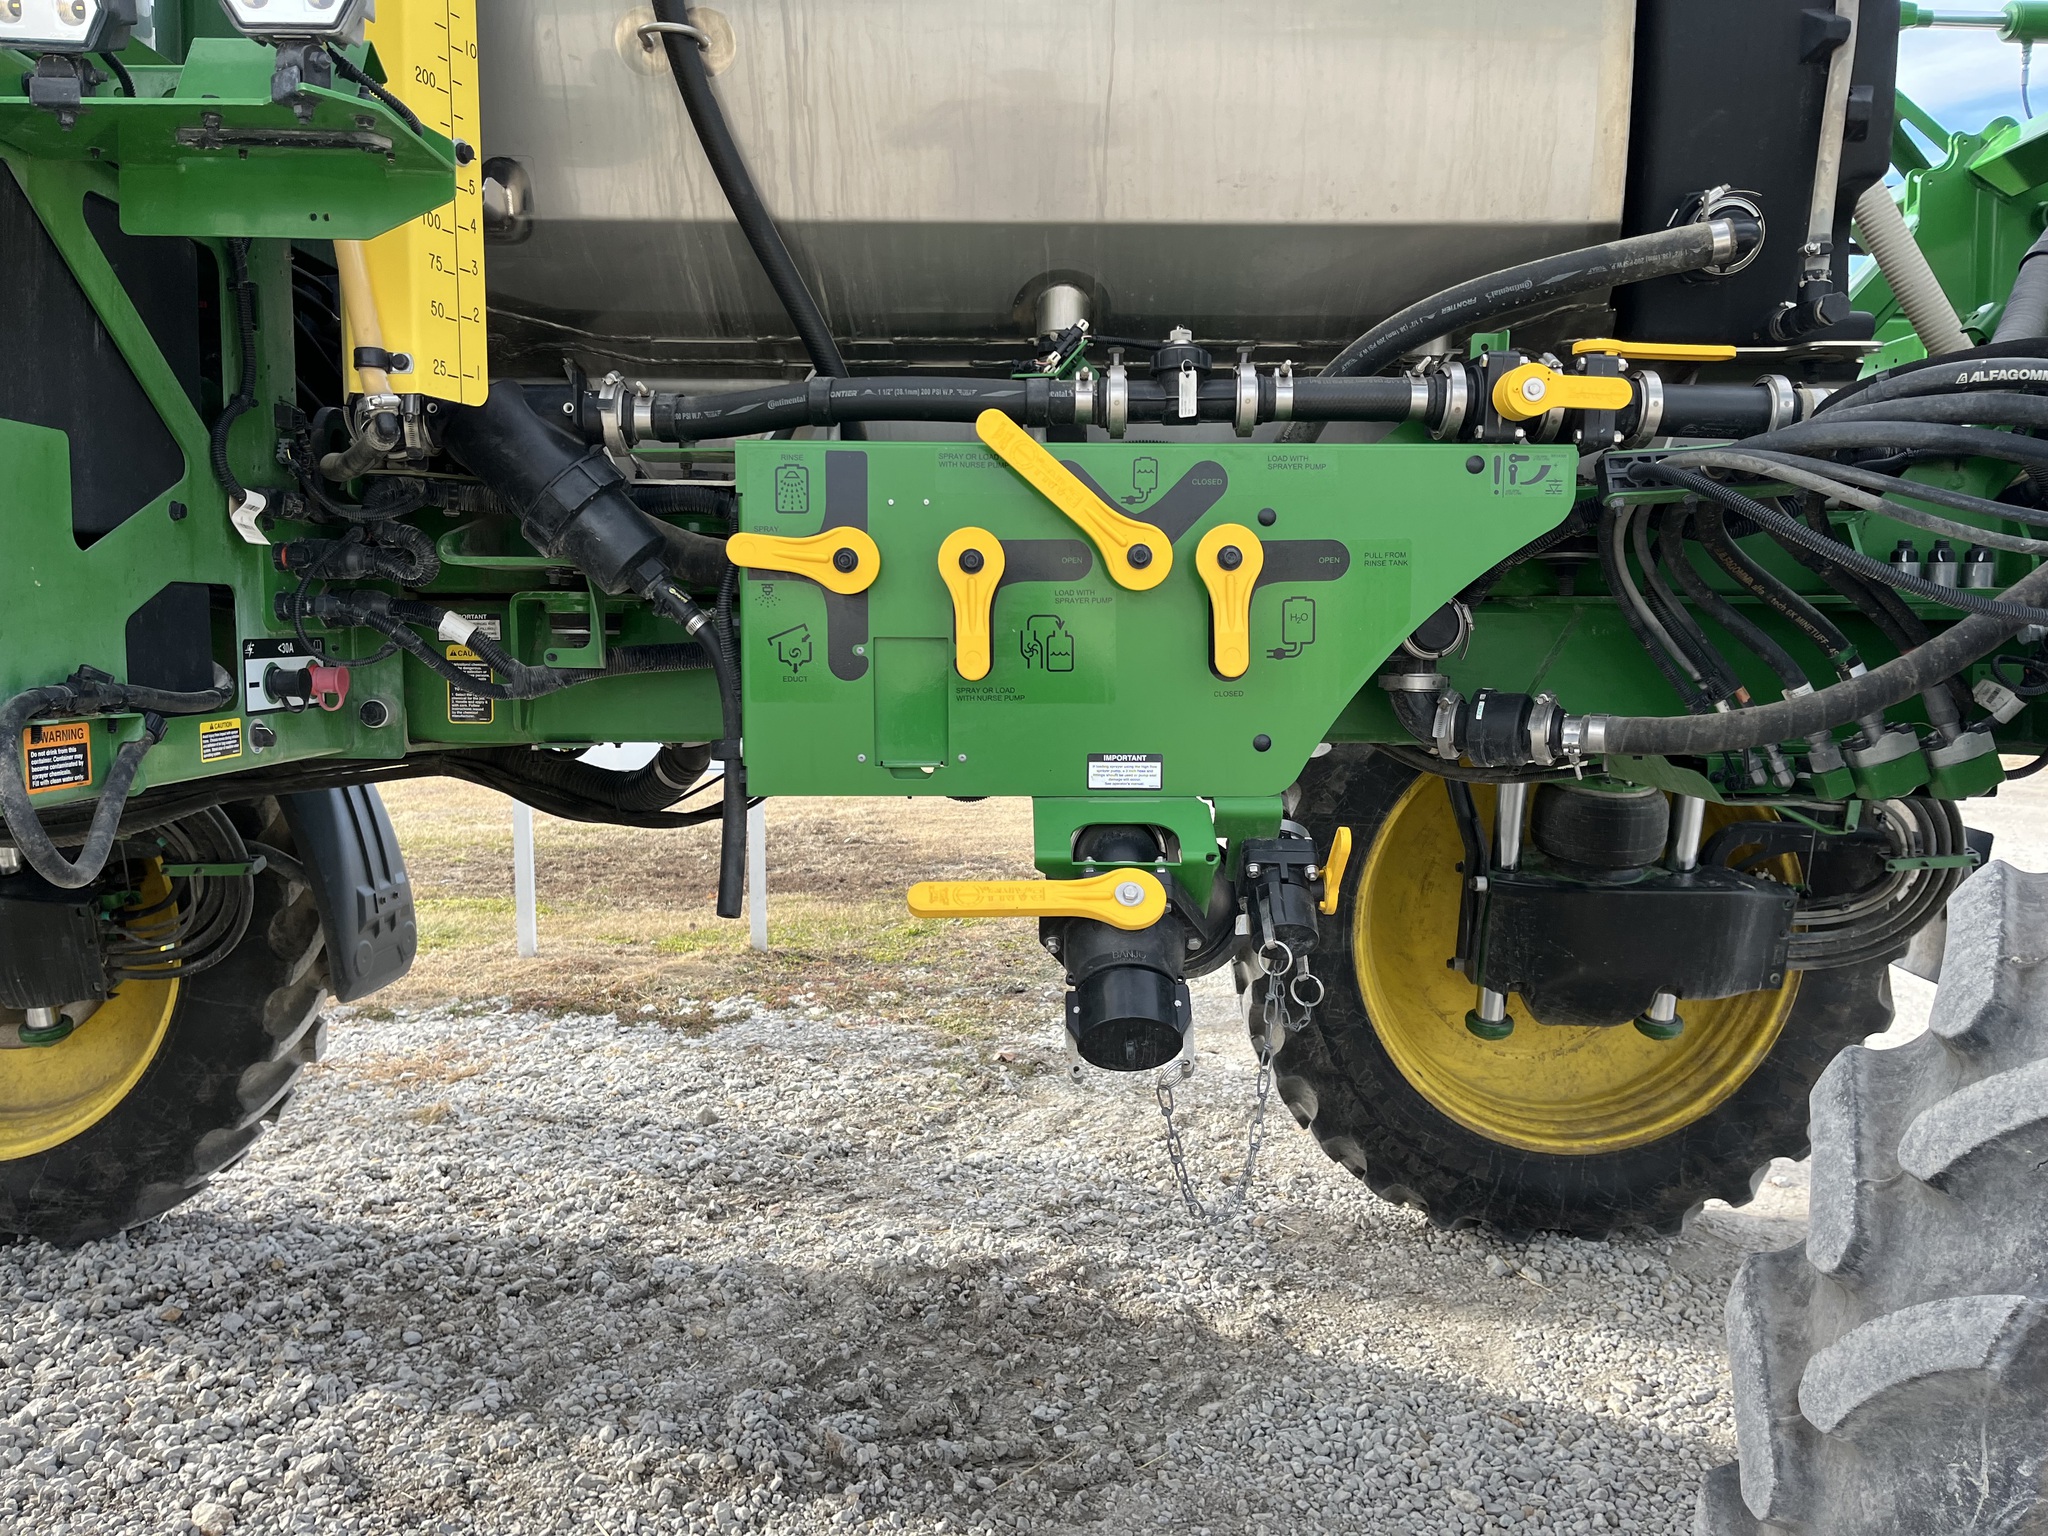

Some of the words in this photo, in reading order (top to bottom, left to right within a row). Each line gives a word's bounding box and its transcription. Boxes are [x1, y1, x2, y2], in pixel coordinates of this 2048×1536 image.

[466, 40, 477, 59] 10
[415, 66, 436, 88] 200
[468, 179, 476, 196] 5
[422, 211, 441, 230] 100
[470, 218, 477, 234] 4
[428, 252, 443, 272] 75
[472, 260, 478, 276] 3
[430, 300, 445, 318] 50
[1441, 297, 1477, 314] FRONTIER
[474, 307, 480, 324] 2
[433, 359, 447, 376] 25
[42, 728, 84, 743] WARNING
[50, 761, 78, 770] contaminated
